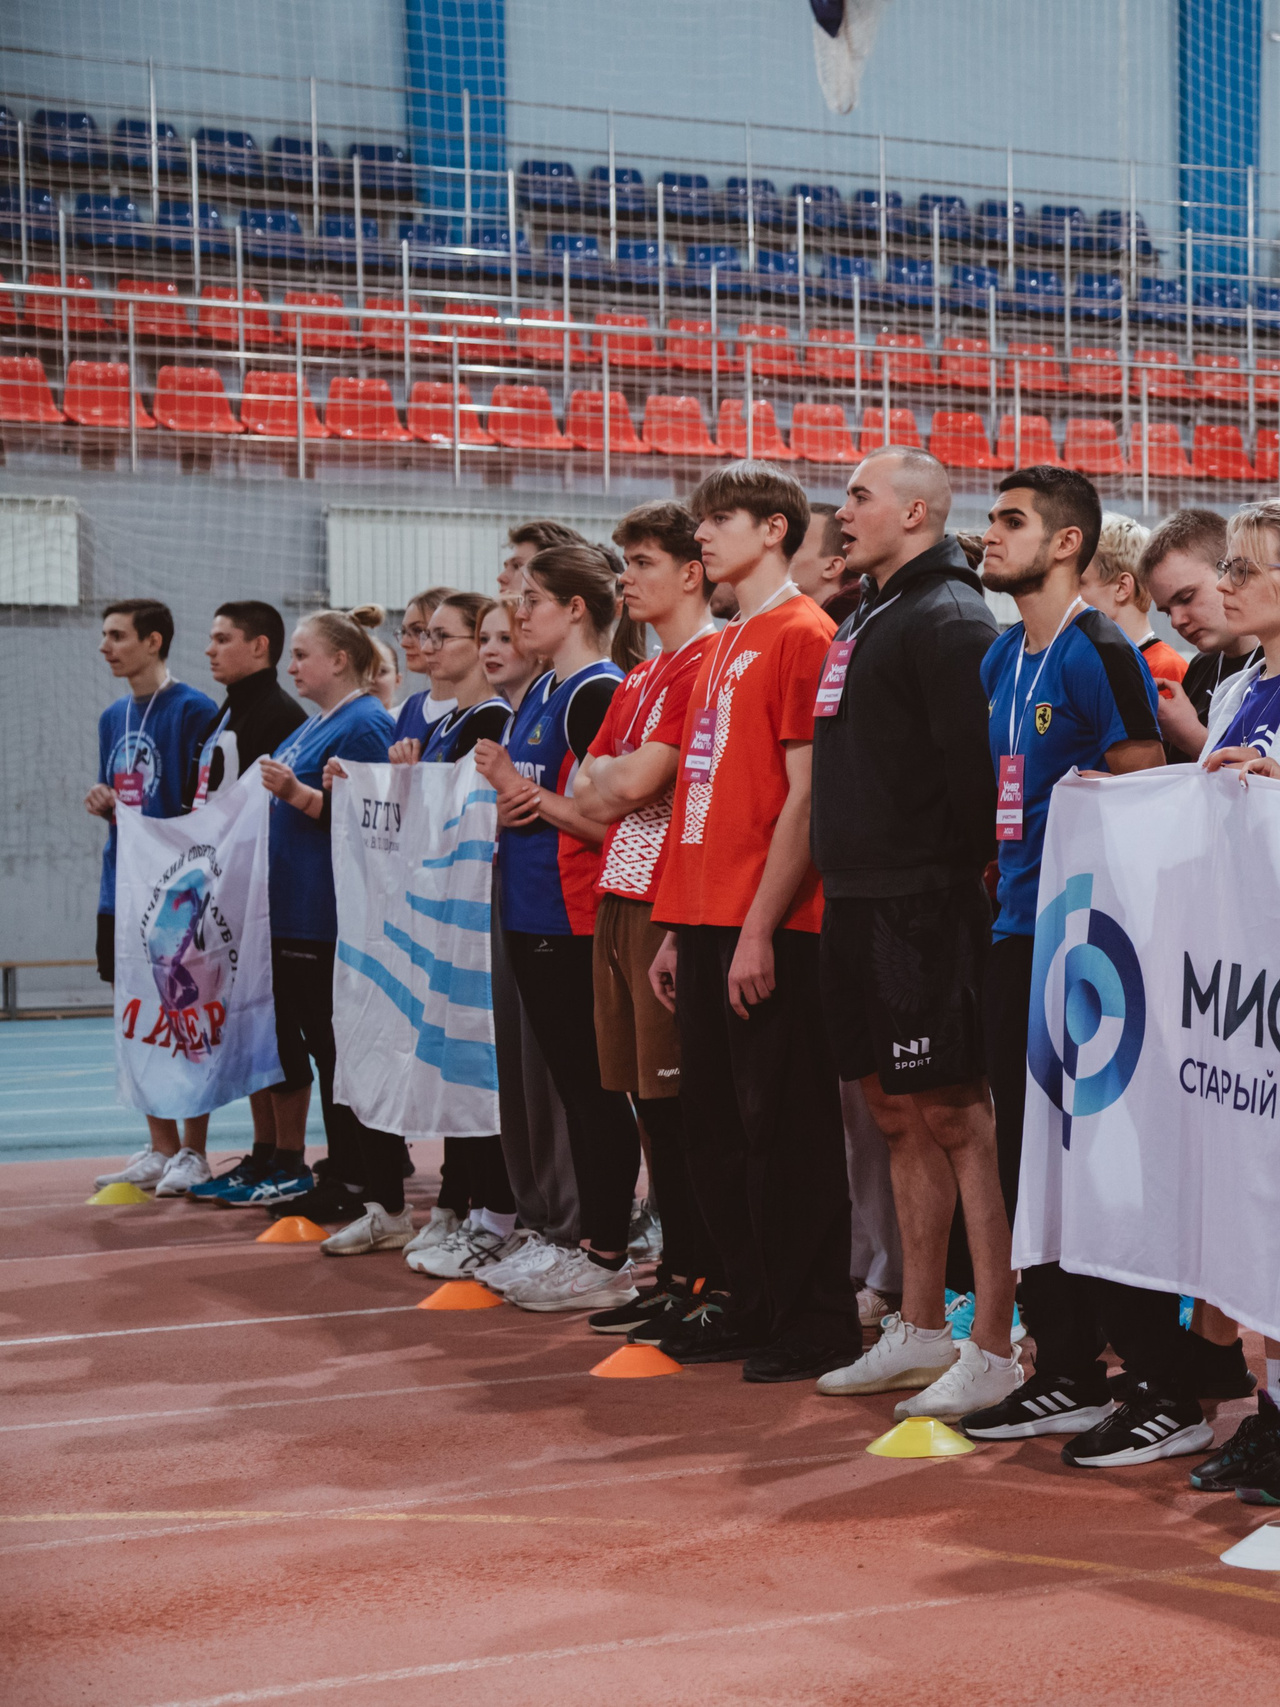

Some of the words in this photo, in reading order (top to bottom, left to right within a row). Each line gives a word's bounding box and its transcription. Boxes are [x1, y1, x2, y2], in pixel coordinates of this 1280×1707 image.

[361, 798, 402, 833] БГТУ
[894, 1056, 932, 1070] SPORT
[1179, 1057, 1276, 1120] СТАРЫЙ
